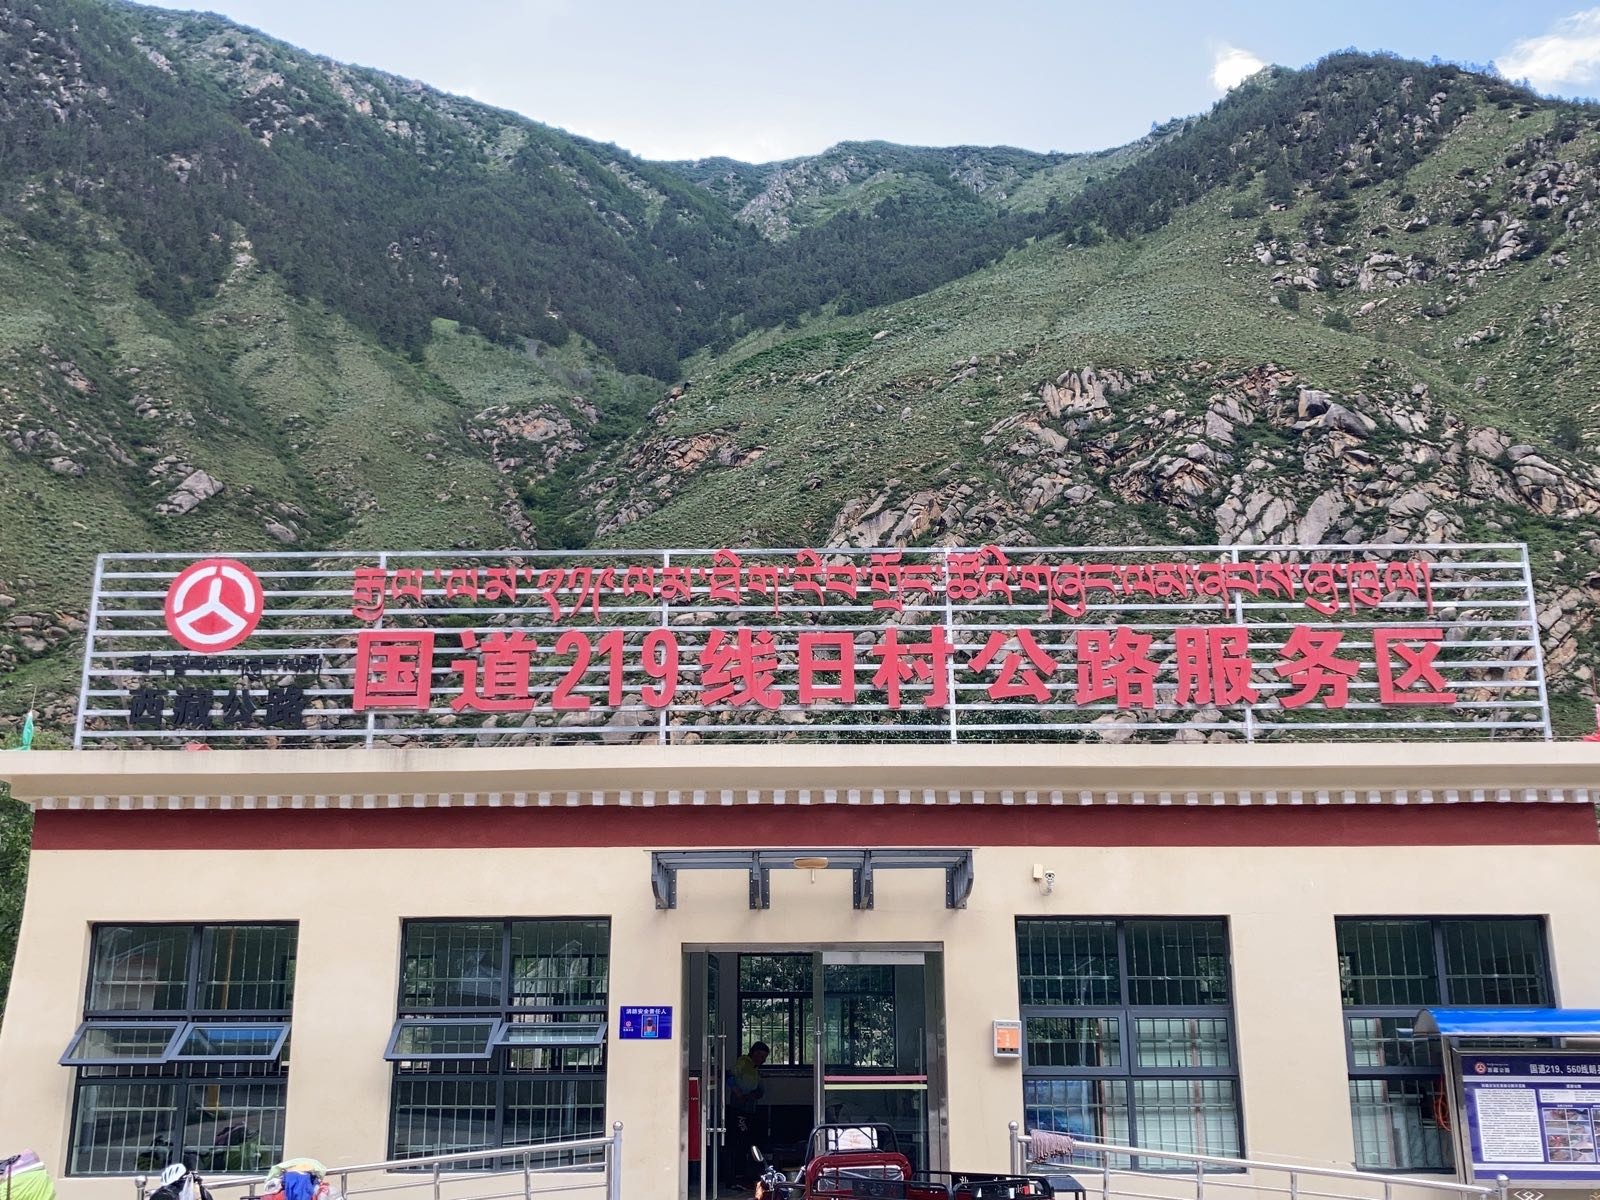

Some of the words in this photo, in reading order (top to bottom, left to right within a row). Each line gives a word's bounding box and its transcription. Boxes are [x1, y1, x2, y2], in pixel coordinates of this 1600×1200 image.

[353, 625, 1457, 712] 国道219线日村公路服务区
[129, 687, 305, 729] 西藏公路
